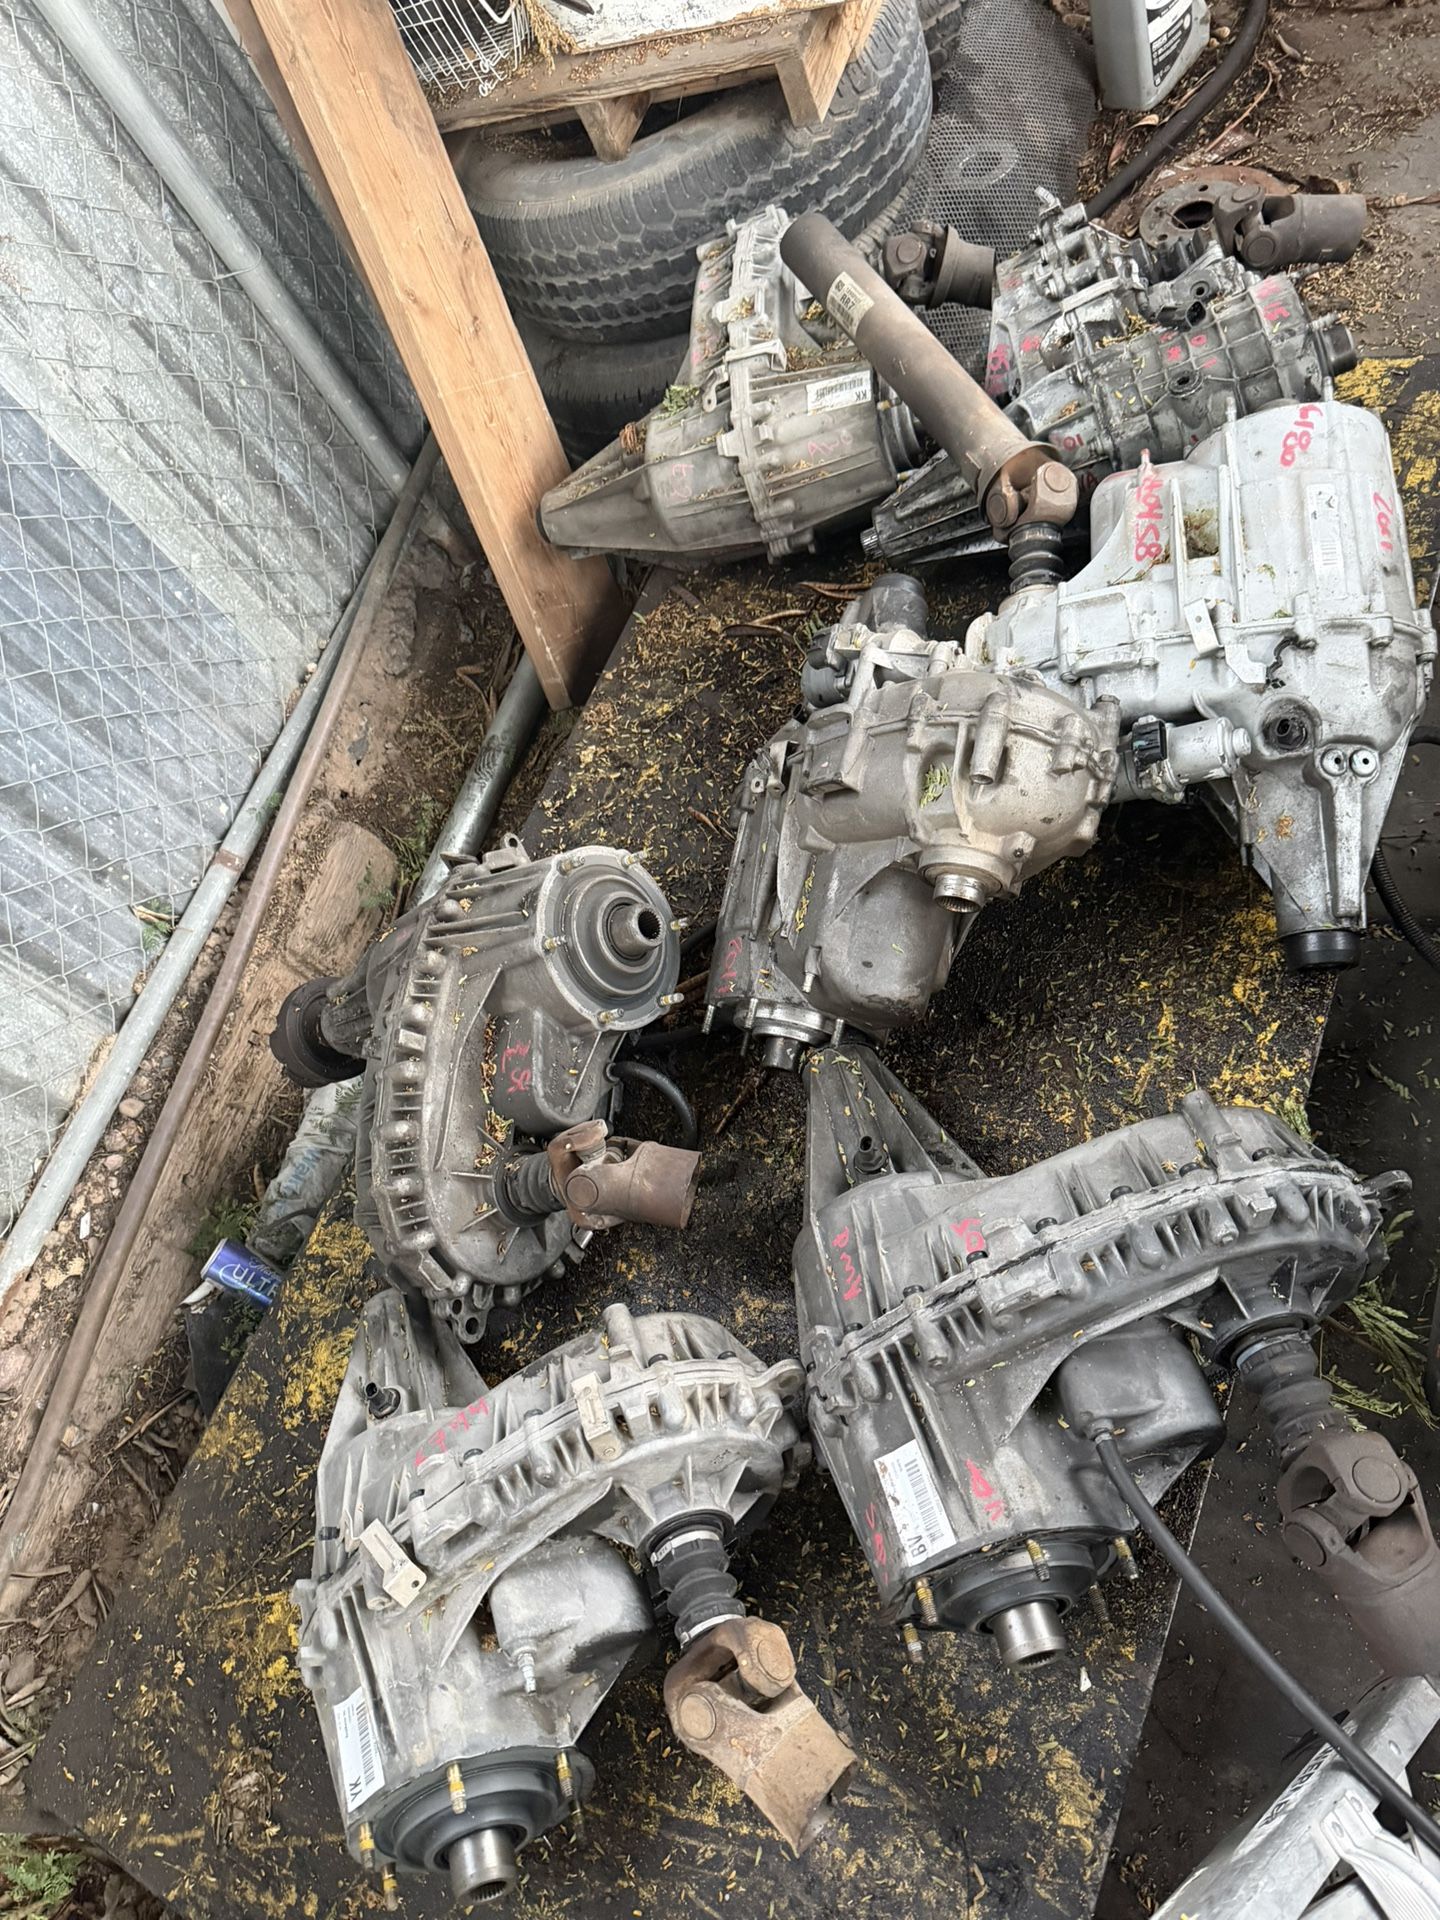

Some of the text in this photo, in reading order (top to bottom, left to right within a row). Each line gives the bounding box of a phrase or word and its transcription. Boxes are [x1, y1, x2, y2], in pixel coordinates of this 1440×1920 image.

[854, 388, 868, 402] KK
[906, 1534, 928, 1559] BV
[348, 1775, 363, 1803] YK
